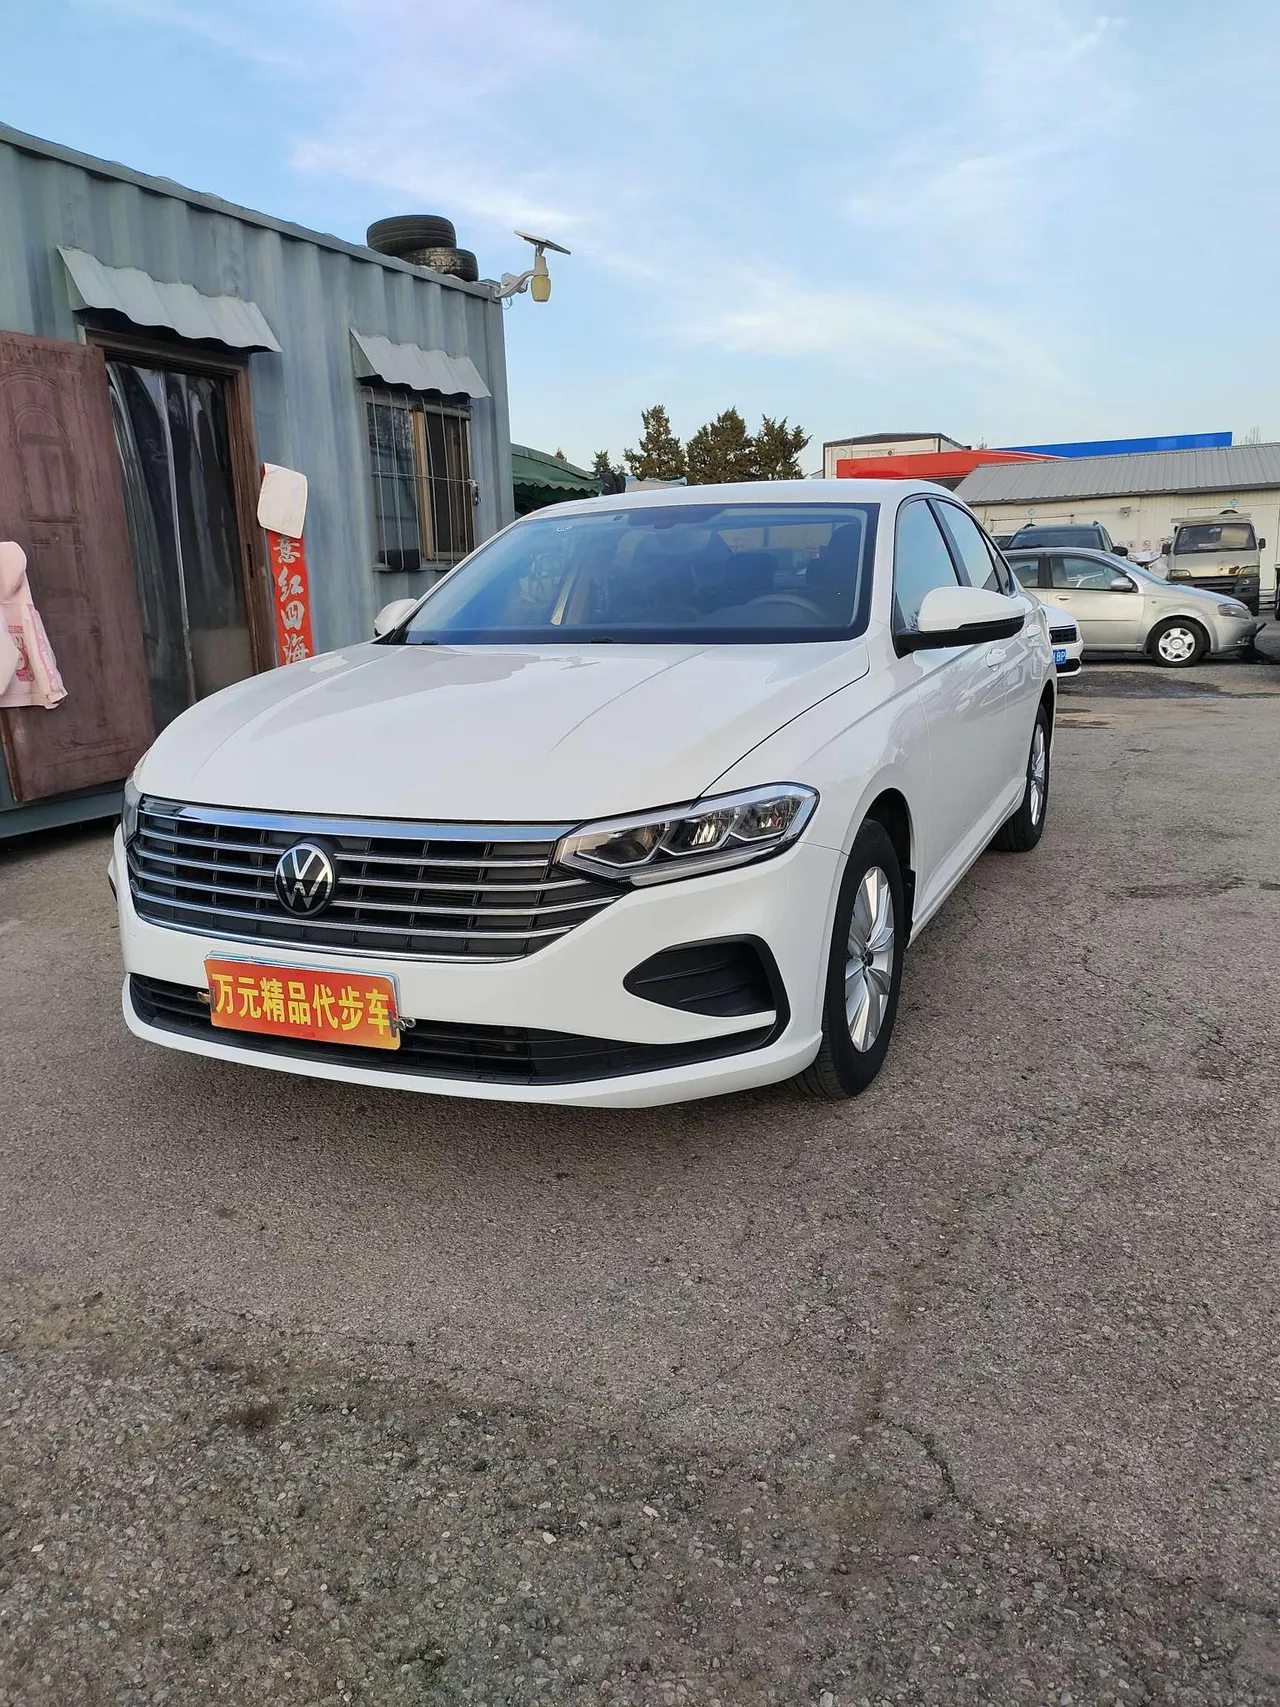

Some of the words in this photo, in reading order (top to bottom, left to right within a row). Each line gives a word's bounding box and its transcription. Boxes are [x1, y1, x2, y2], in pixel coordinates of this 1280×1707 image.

[1053, 651, 1066, 662] BP
[212, 974, 390, 1035] 万元精品代步车
